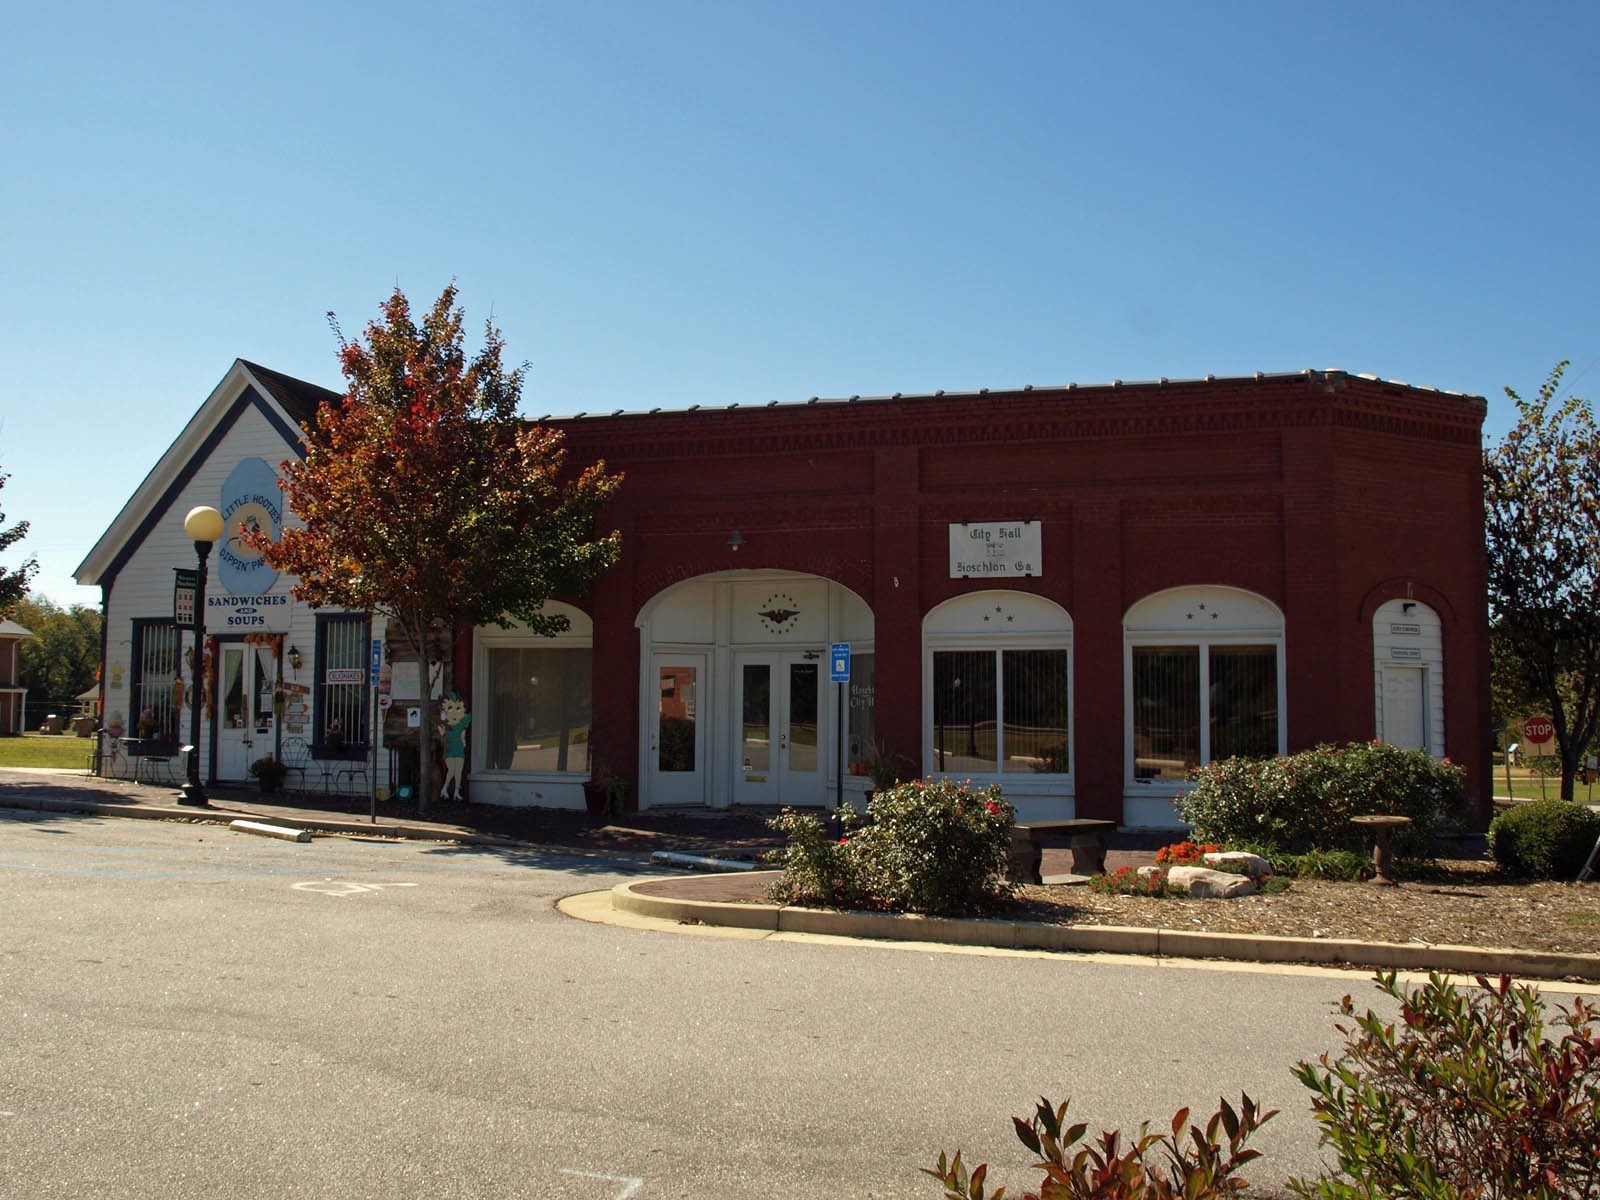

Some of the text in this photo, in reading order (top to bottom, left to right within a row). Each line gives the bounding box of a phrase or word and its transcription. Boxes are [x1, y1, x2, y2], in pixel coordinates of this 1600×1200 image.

[221, 494, 249, 521] LITTLE
[970, 527, 1021, 542] City Hall
[956, 561, 1006, 573] Hoschton
[207, 595, 287, 606] SANDWICHES
[227, 616, 265, 625] SOUPS
[1525, 724, 1551, 736] STOP
